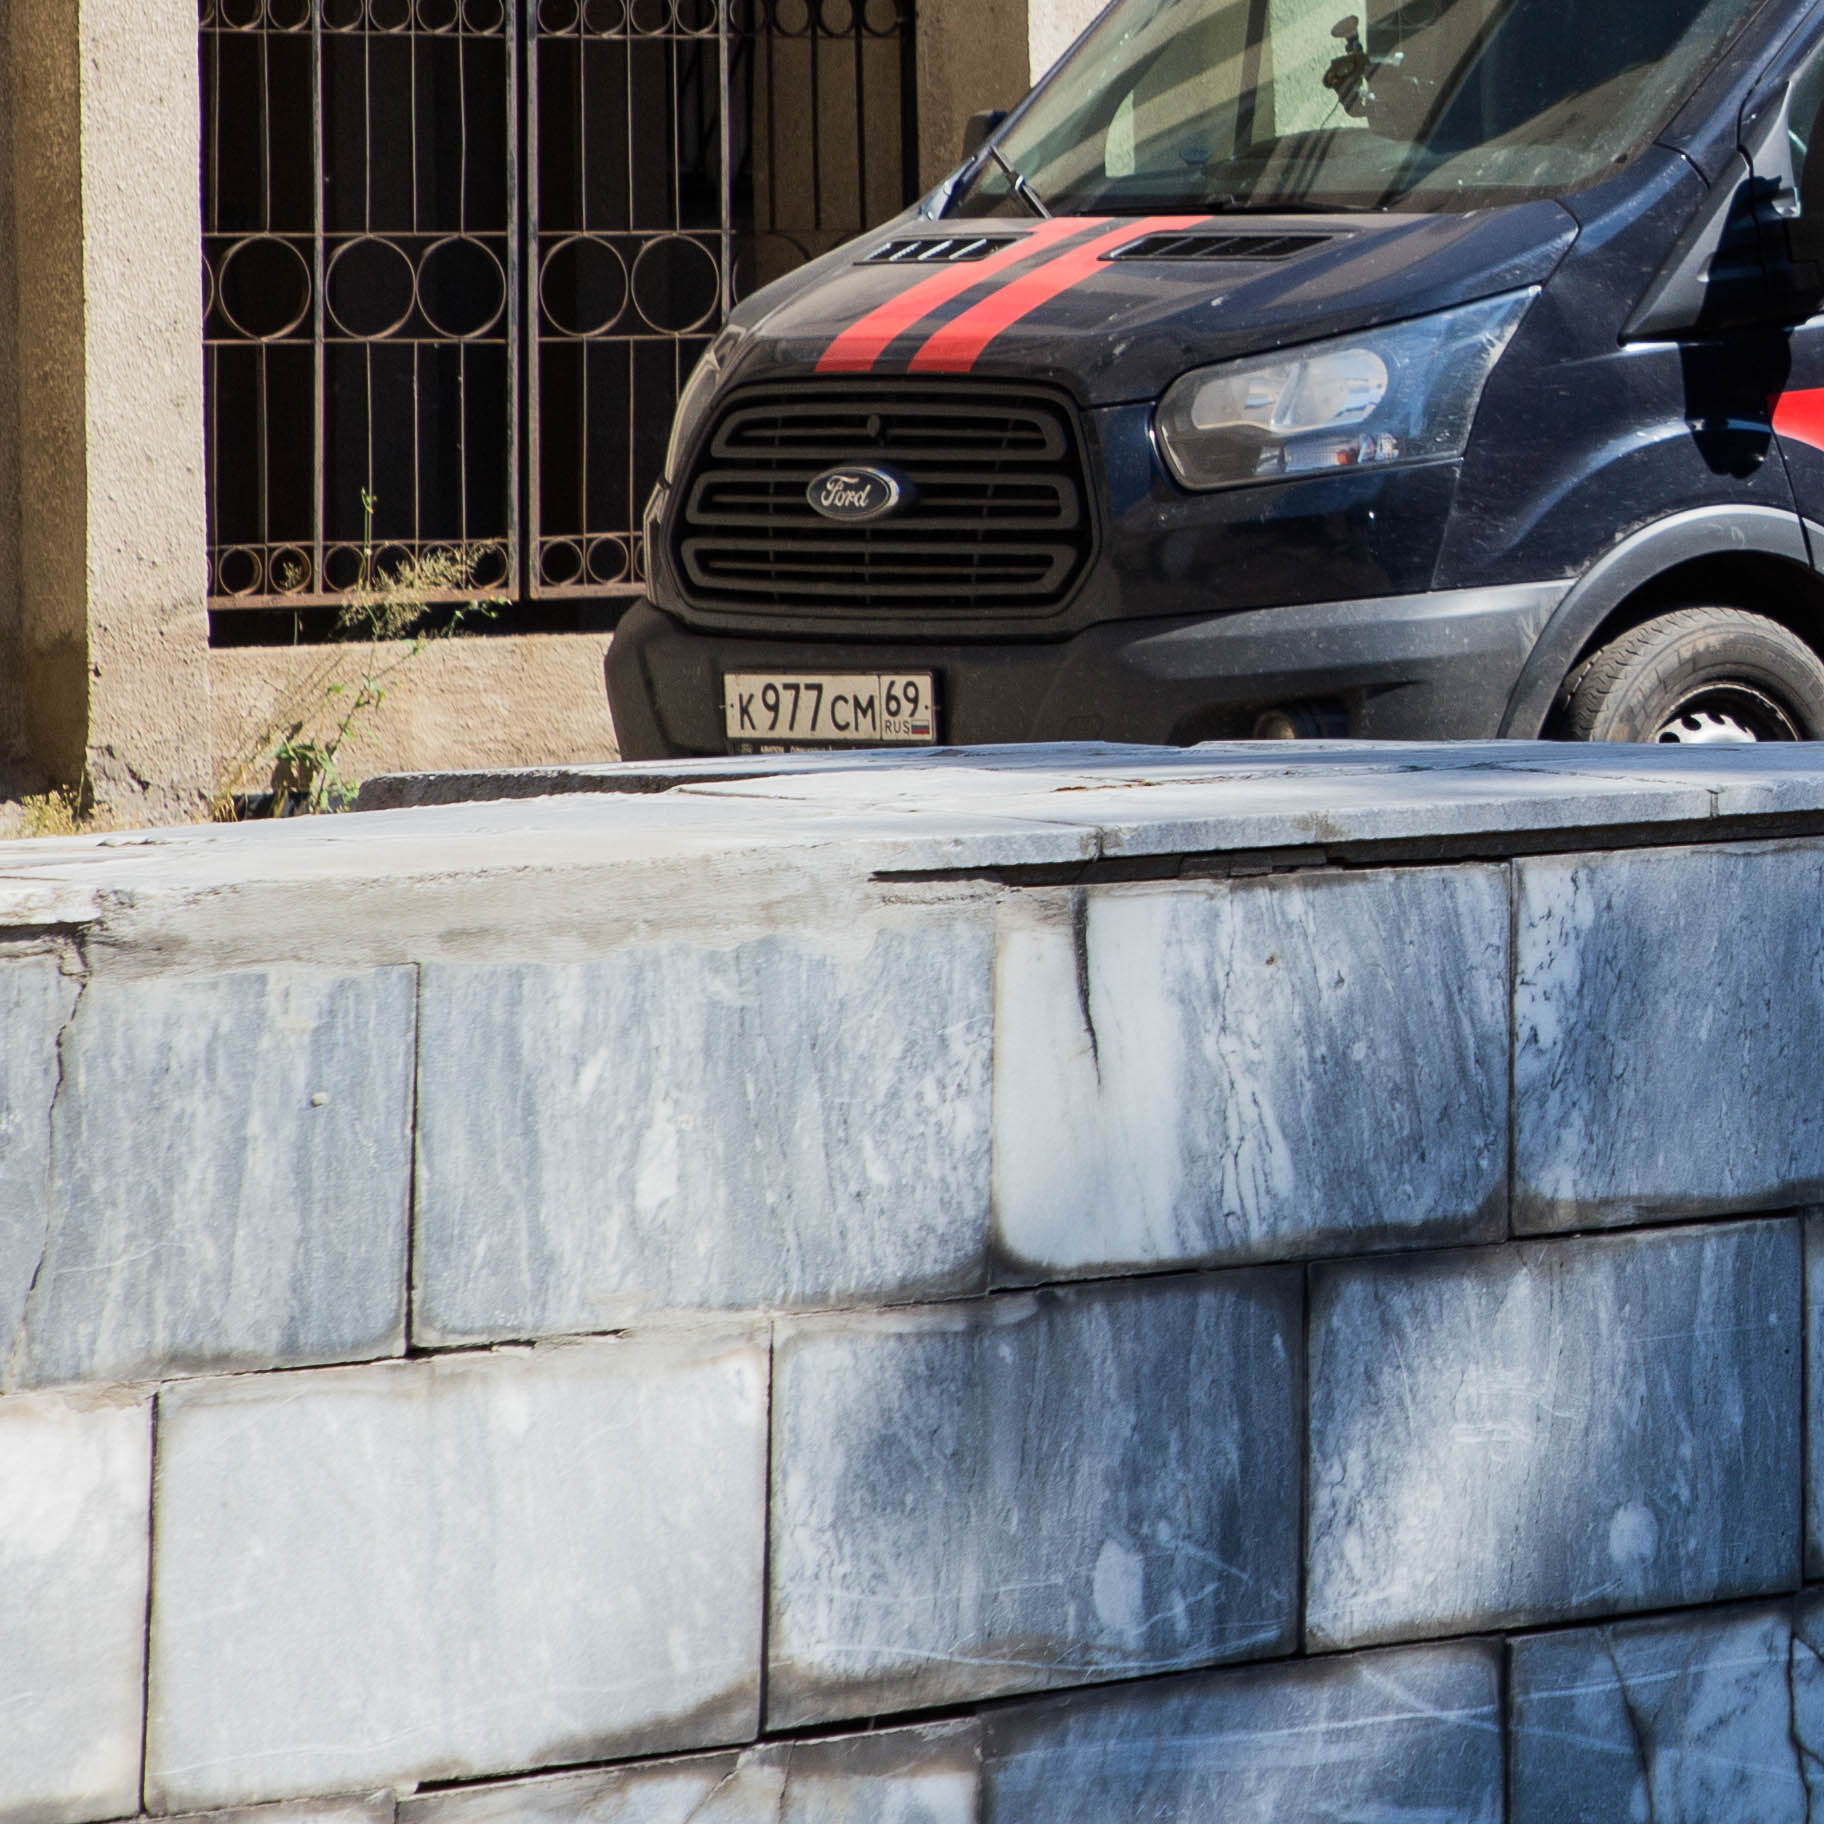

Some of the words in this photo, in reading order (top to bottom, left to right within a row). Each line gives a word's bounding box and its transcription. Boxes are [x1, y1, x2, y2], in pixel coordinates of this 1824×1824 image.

[821, 475, 872, 507] Ford
[738, 682, 877, 732] К977СМ
[884, 680, 920, 718] 69
[884, 720, 911, 734] RUS
